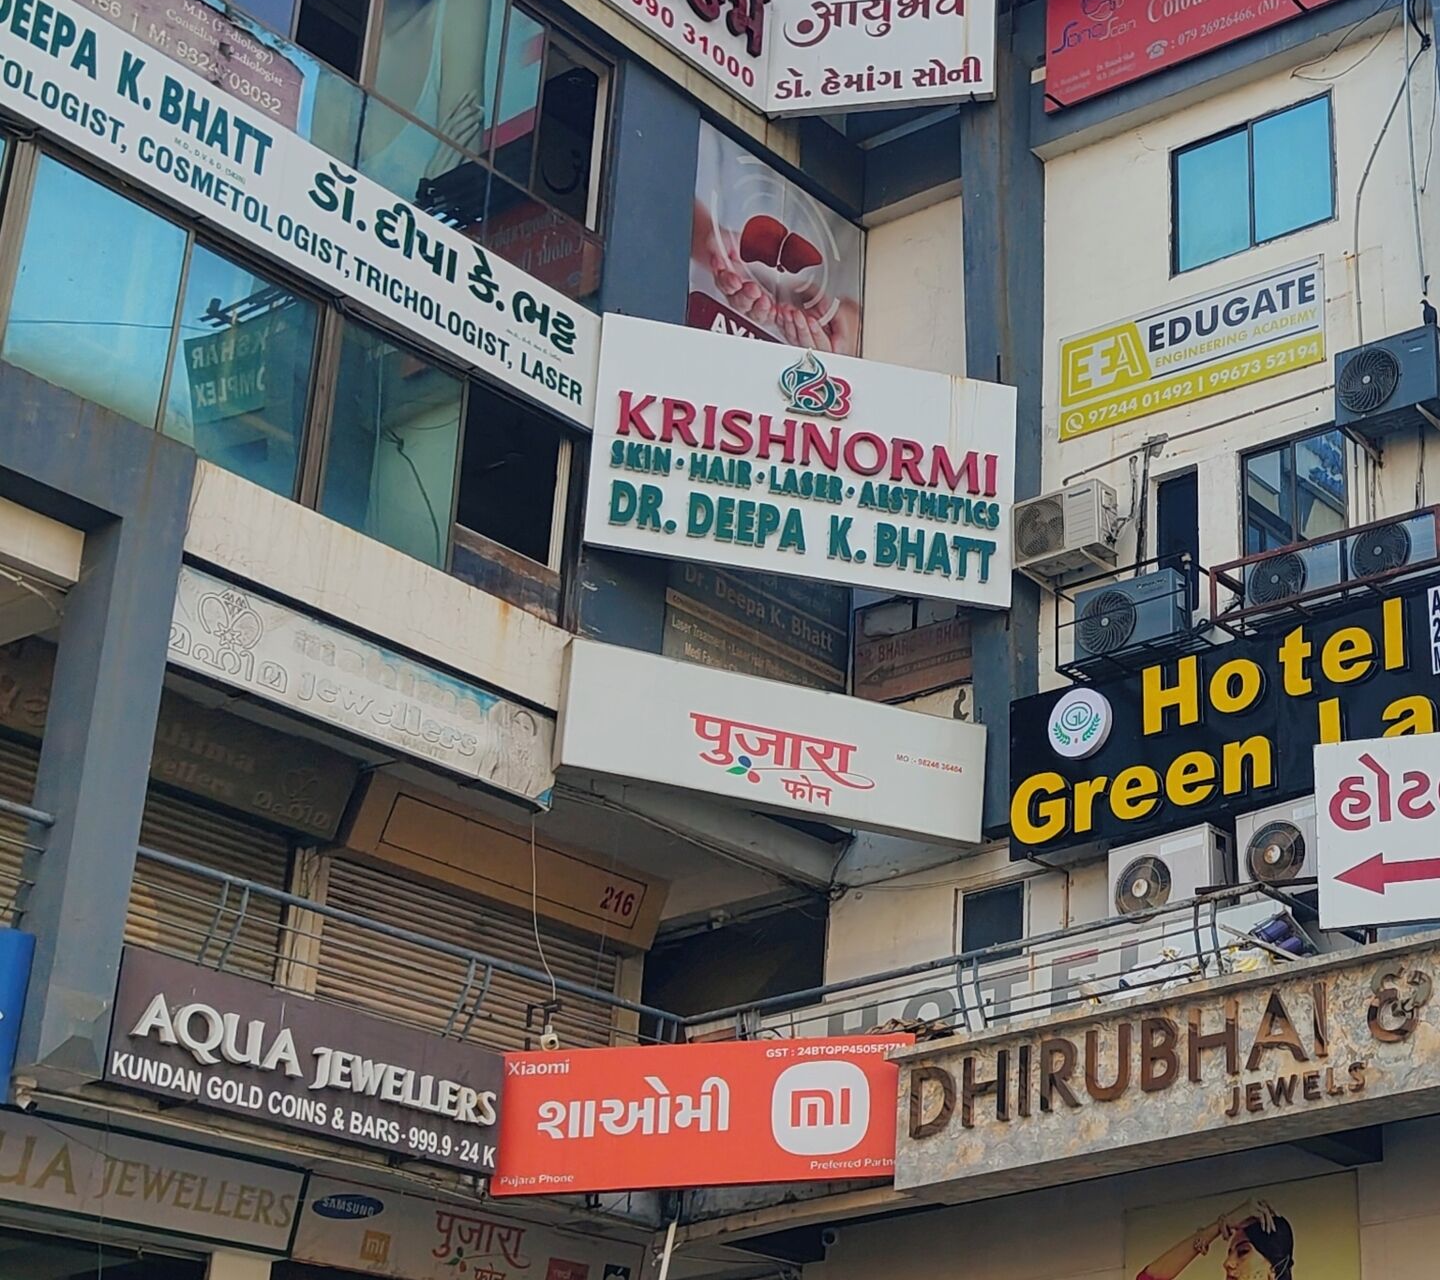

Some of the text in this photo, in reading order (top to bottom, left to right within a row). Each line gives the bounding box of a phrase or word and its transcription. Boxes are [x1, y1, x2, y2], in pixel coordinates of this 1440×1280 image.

[683, 23, 754, 88] 31000
[820, 56, 982, 96] હેમાંગ સોની
[117, 51, 152, 112] K.
[160, 82, 272, 176] BHATT
[375, 202, 458, 284] દીપા
[468, 244, 506, 312] કે.
[512, 290, 578, 355] ભટ્ટ
[1148, 273, 1315, 352] EDUGATE
[1155, 308, 1317, 368] ENGINEERING ACADEMY
[521, 350, 584, 405] LASER
[1088, 342, 1318, 423] 97244 01492 99673 52194
[617, 391, 998, 498] KRISHNORMI
[611, 440, 1000, 530] SKIN HAIR LASER AESTHETICS
[609, 480, 997, 584] DR. DEEPA K. BHATT
[715, 579, 766, 620] Deepa
[792, 620, 834, 653] Bhatt
[1142, 597, 1405, 736] Hotel
[690, 712, 875, 789] पुजारा
[780, 775, 833, 806] फोन
[1010, 736, 1272, 845] Green
[600, 886, 635, 917] 216
[129, 992, 498, 1127] AQUA JEWELLERS
[508, 1059, 570, 1077] Xiaomi
[766, 1048, 789, 1058] GST
[909, 981, 1330, 1140] DHIRUBHAI
[1367, 962, 1432, 1043] &
[111, 1051, 345, 1131] KUNDAN GOLD COINS &
[538, 1076, 730, 1140] શાઓમી
[1226, 1062, 1368, 1118] JEWELS
[93, 1156, 295, 1228] JEWELLERS
[539, 1173, 574, 1184] Phone
[810, 1158, 862, 1170] Preferred
[322, 1196, 374, 1217] SAMSUNG
[432, 1210, 531, 1268] पुजारा
